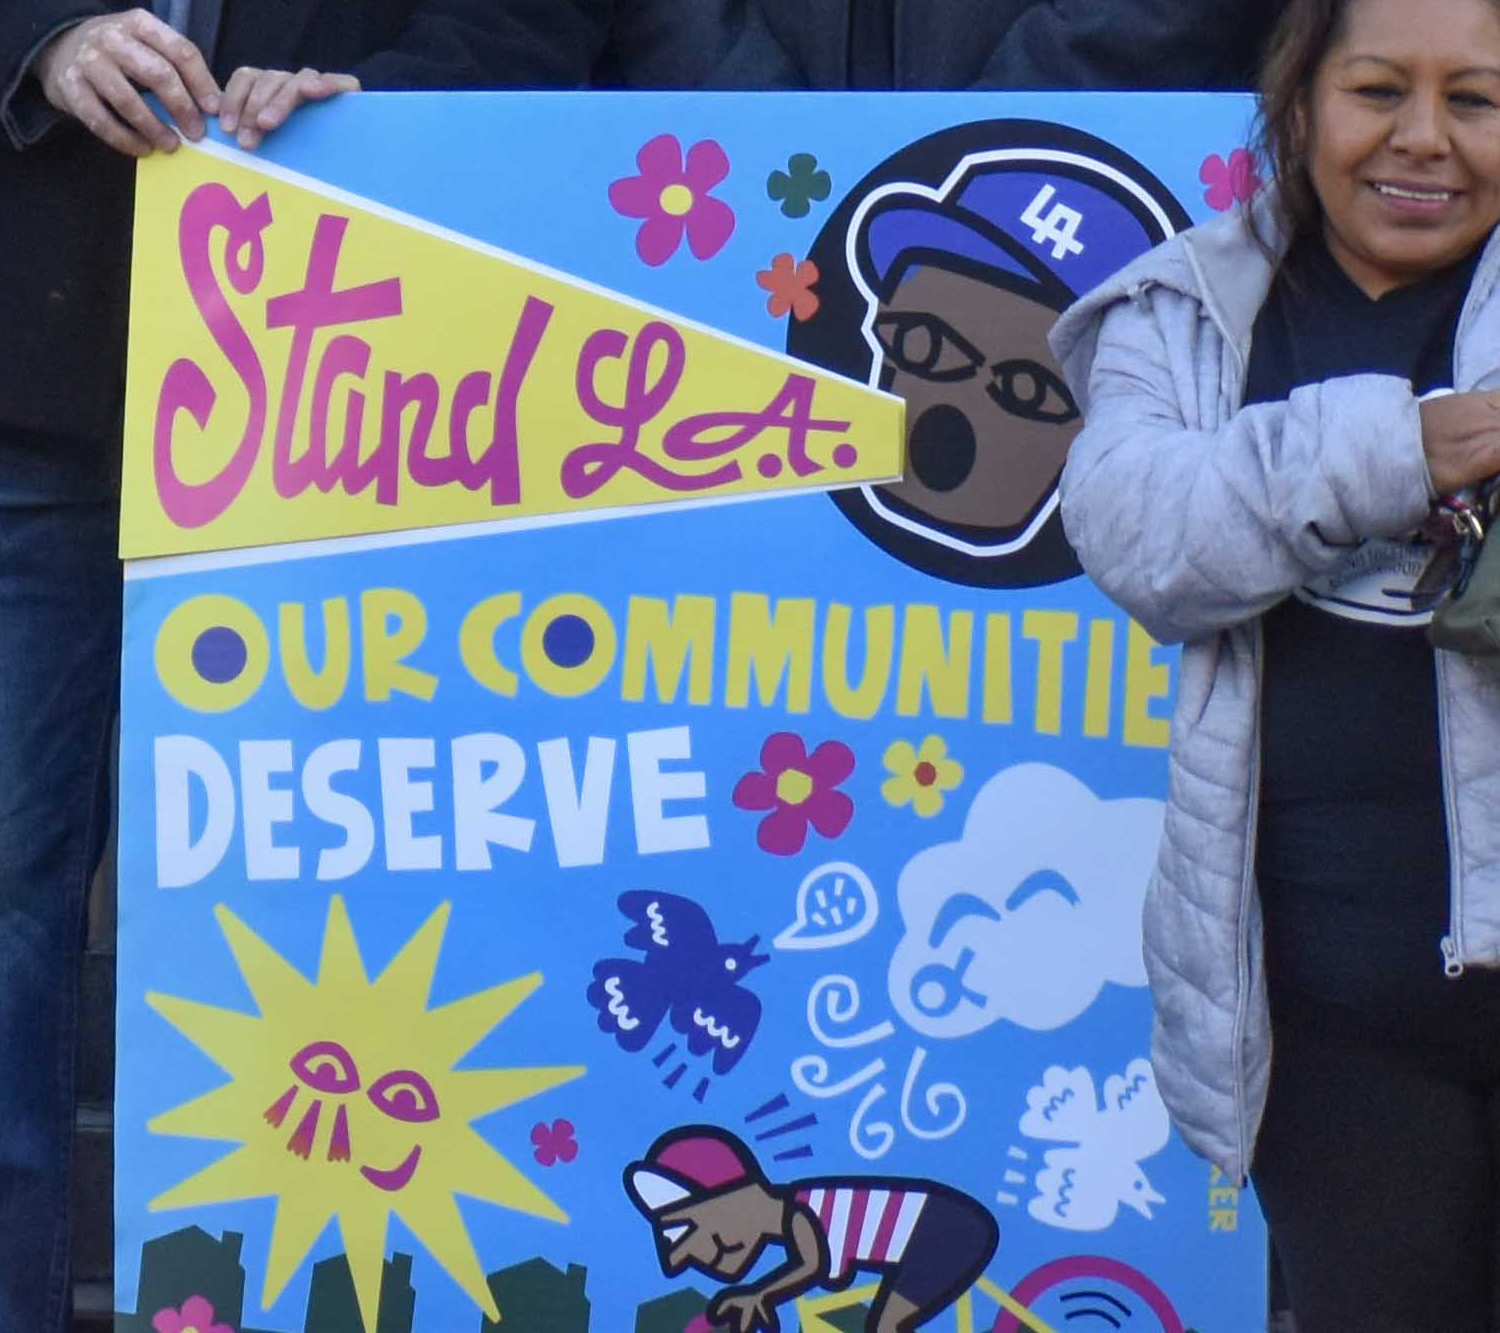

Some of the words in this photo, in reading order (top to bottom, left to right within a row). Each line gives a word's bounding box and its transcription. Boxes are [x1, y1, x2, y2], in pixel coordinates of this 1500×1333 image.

[153, 181, 556, 531] Stand
[560, 320, 859, 501] L.A.
[154, 588, 437, 716] OUR
[154, 724, 712, 890] DESERVE
